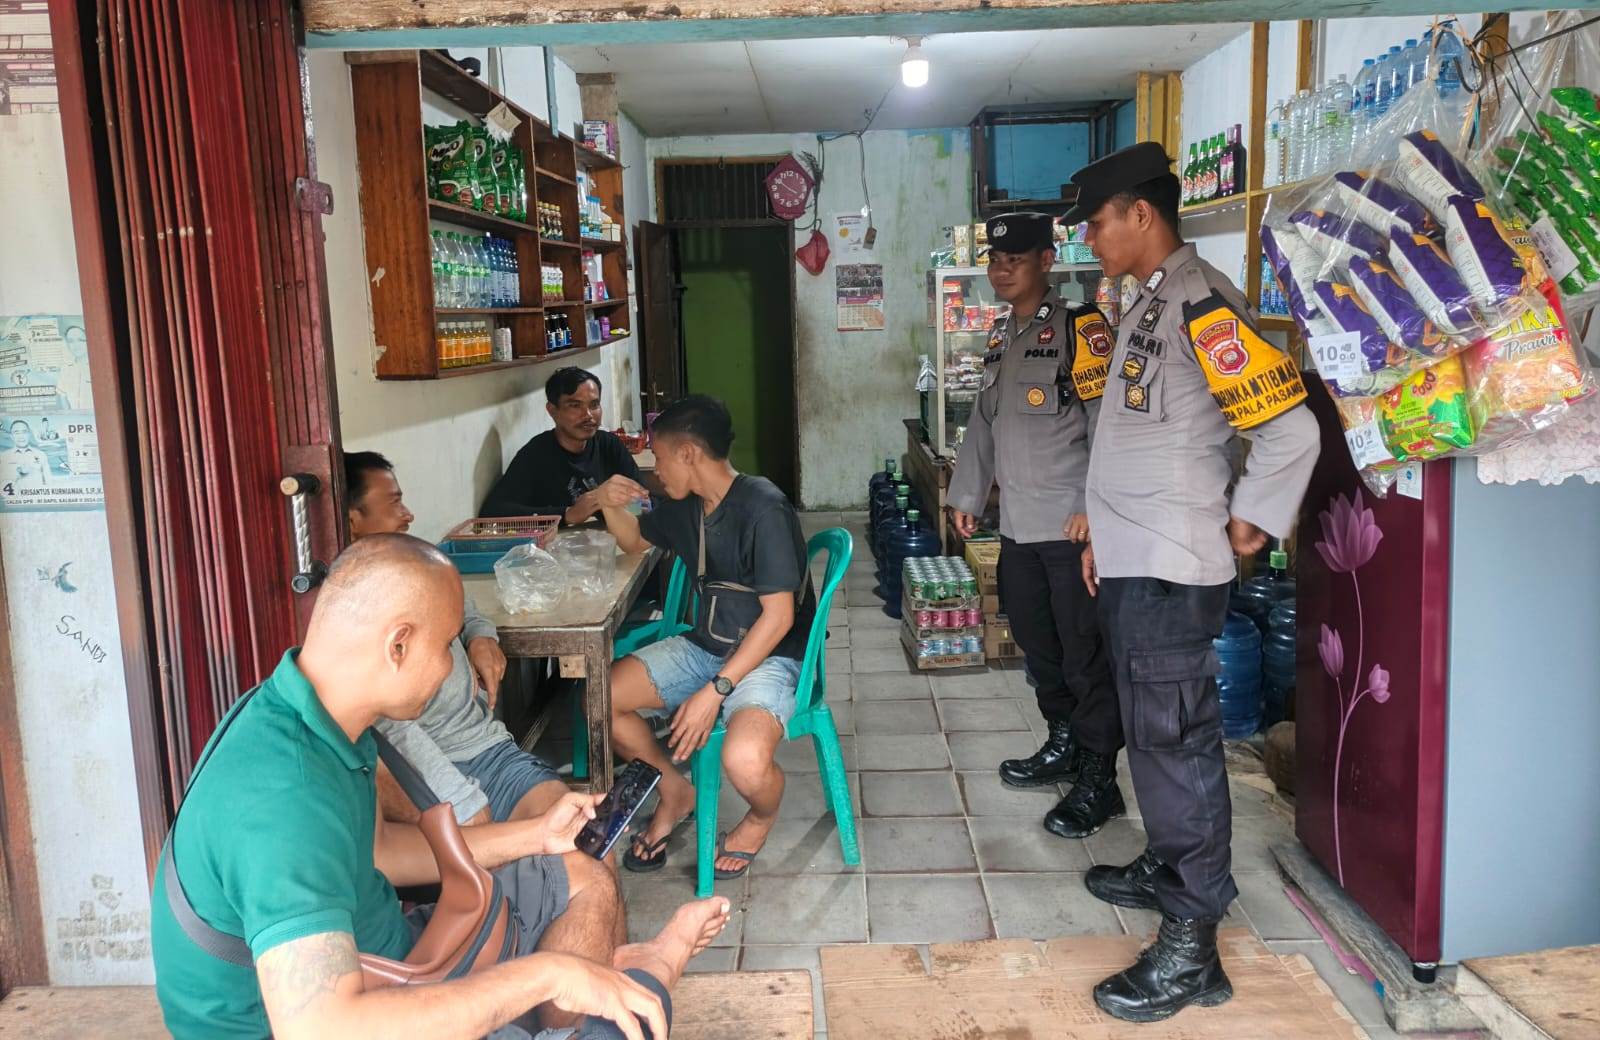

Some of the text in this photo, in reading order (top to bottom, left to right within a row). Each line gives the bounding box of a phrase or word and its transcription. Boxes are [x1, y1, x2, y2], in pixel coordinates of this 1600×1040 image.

[1128, 332, 1162, 356] POLRI
[1504, 335, 1557, 361] Prawn
[1024, 348, 1059, 358] POLRI
[1316, 345, 1338, 361] 10
[1074, 363, 1108, 385] BHABINK
[1236, 400, 1266, 419] PALA
[1265, 381, 1304, 408] PASANG
[68, 424, 94, 434] DPR
[1349, 434, 1364, 451] 10
[3, 482, 15, 496] 4
